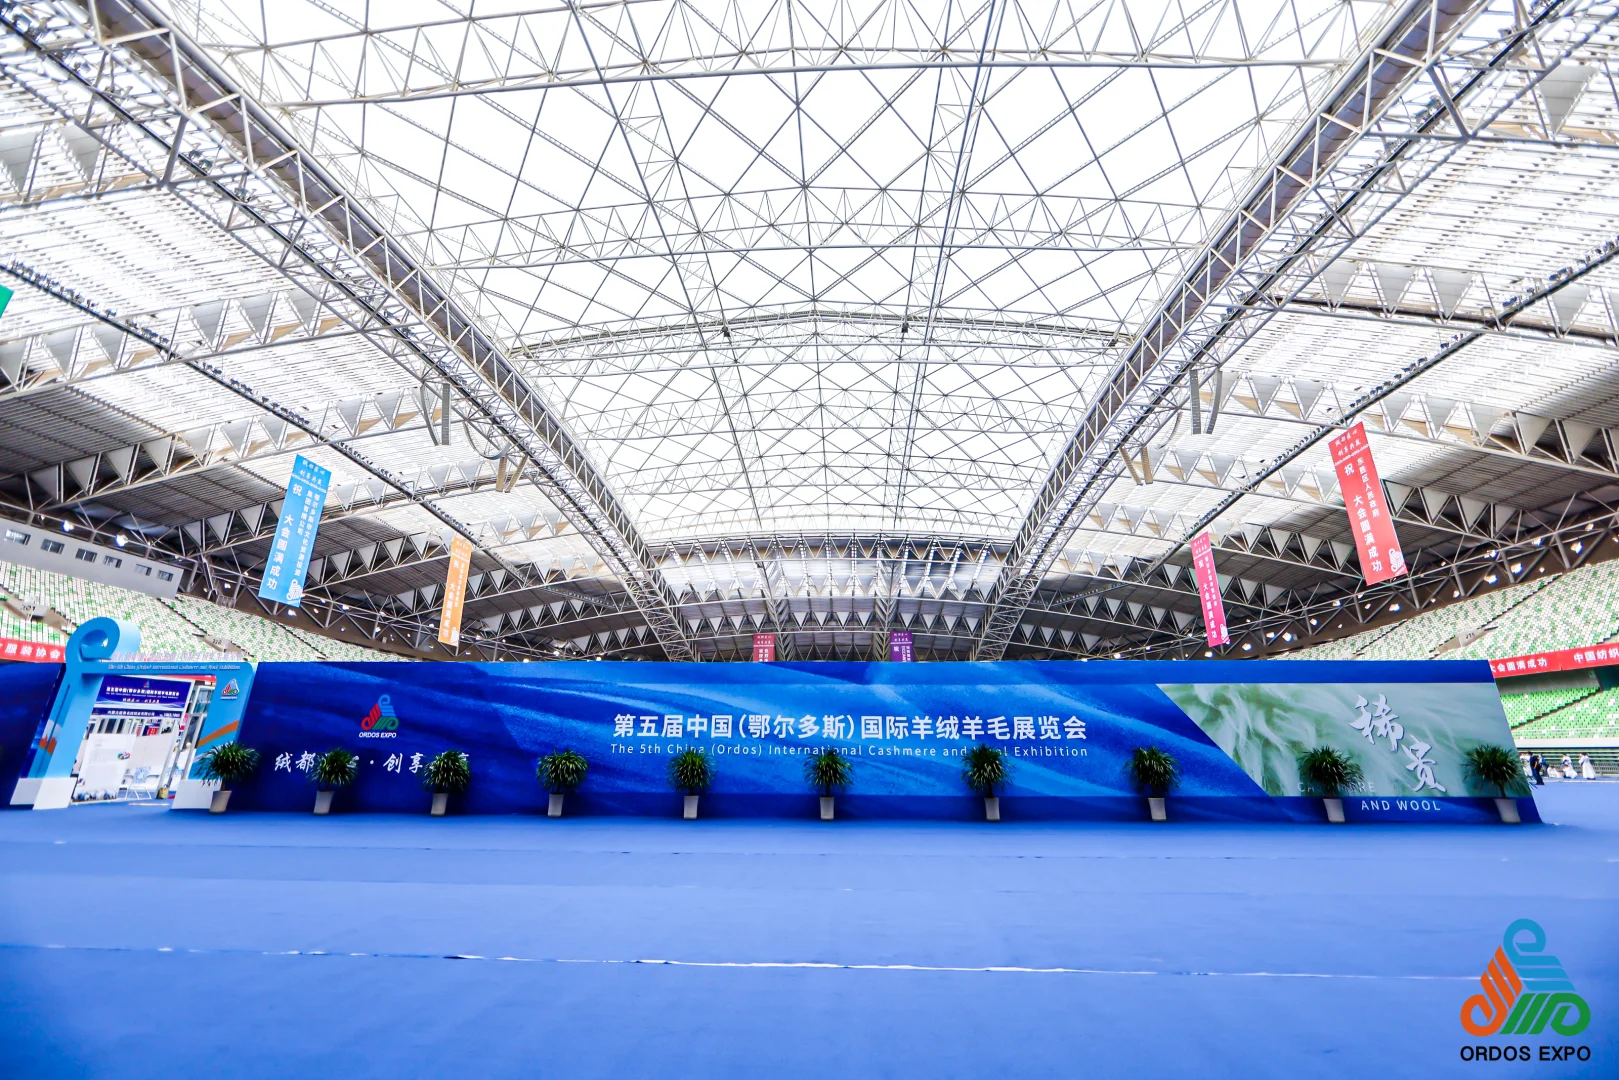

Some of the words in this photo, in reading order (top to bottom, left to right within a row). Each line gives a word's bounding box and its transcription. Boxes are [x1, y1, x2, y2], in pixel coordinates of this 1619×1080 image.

[292, 484, 302, 496] 祝
[1344, 463, 1354, 476] 祝
[1353, 495, 1382, 572] 大会圆满成功
[267, 514, 294, 590] 大会圆满成功
[0, 643, 60, 659] 服装协会
[613, 714, 1087, 740] 第五届中国(鄂尔多斯)国际羊绒羊毛展览会
[611, 744, 633, 754] The
[640, 744, 661, 754] 5th
[712, 743, 762, 756] (Ordos)
[869, 746, 936, 756] Cashmere
[943, 746, 967, 756] and
[1015, 746, 1088, 757] Exhibition
[1361, 800, 1390, 811] AND
[1397, 800, 1441, 811] WOOL
